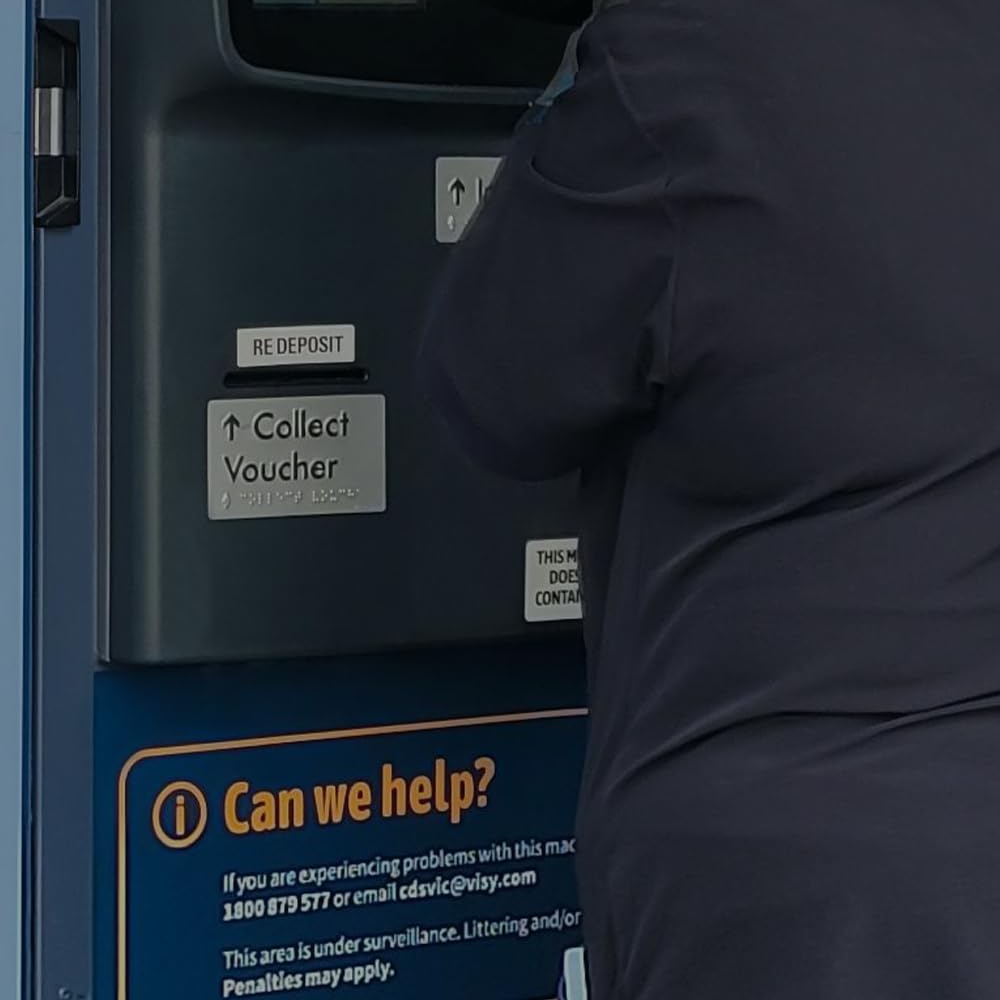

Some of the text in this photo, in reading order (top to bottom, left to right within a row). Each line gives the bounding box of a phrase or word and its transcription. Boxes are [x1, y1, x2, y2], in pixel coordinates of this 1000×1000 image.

[253, 408, 350, 440] Collect
[223, 451, 339, 483] Voucher
[536, 549, 565, 565] THIS
[224, 757, 496, 834] Can we help?
[223, 872, 236, 893] If
[236, 874, 267, 896] you
[270, 870, 297, 887] are
[299, 856, 400, 886] experiencing
[403, 849, 476, 876] problems
[478, 842, 512, 863] with
[515, 839, 542, 859] this
[223, 870, 537, 921] 1800 879 577 or email cdsvic@visy.com
[223, 908, 582, 969] This area is under surveillance. Littering and/or
[223, 958, 395, 998] Penalties may apply.
